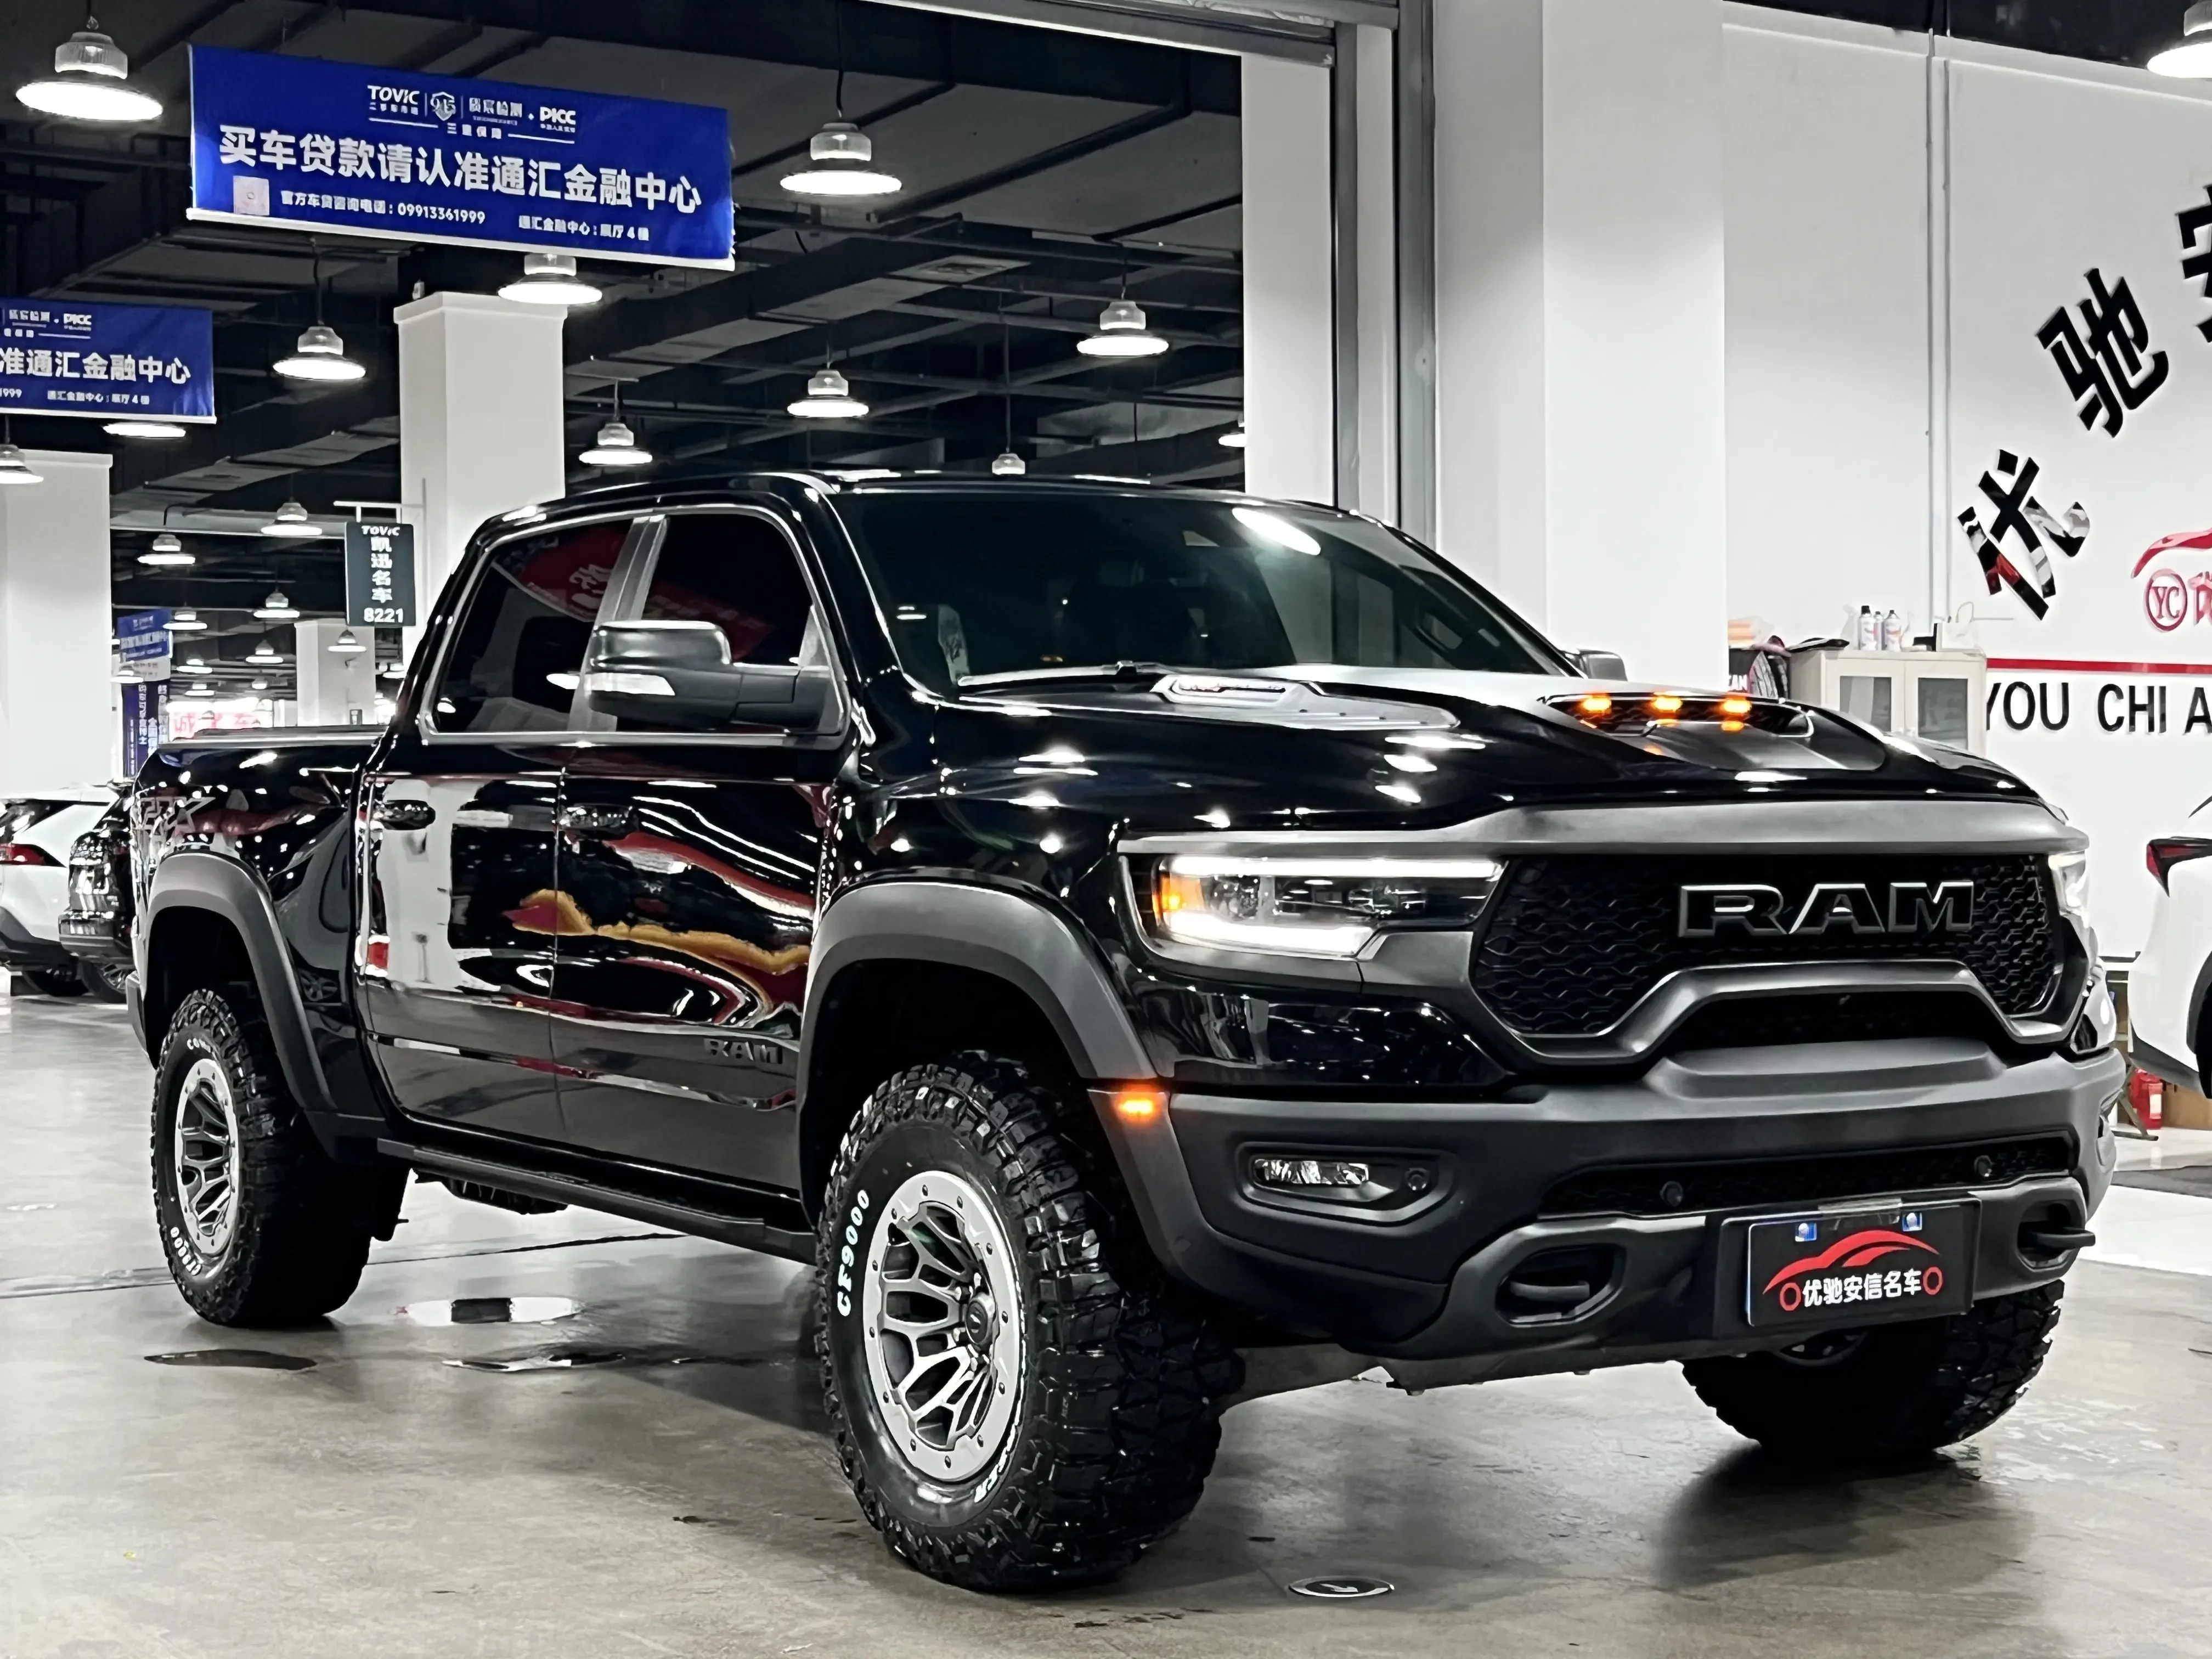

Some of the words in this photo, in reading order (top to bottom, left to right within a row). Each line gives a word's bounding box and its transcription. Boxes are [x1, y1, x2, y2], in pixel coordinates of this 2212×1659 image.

[367, 84, 420, 105] TOVIC
[540, 106, 576, 125] PICC
[219, 125, 702, 214] 买车贷款请认准通汇金融中心
[397, 202, 485, 224] 09913361999
[361, 525, 400, 536] TOVIC
[364, 607, 403, 623] 8221
[2152, 586, 2180, 619] YC
[2097, 684, 2167, 733] CHI
[1678, 880, 1974, 937] RAM
[704, 1038, 783, 1064] RAM
[1803, 1268, 1922, 1307] 优驰安信名车
